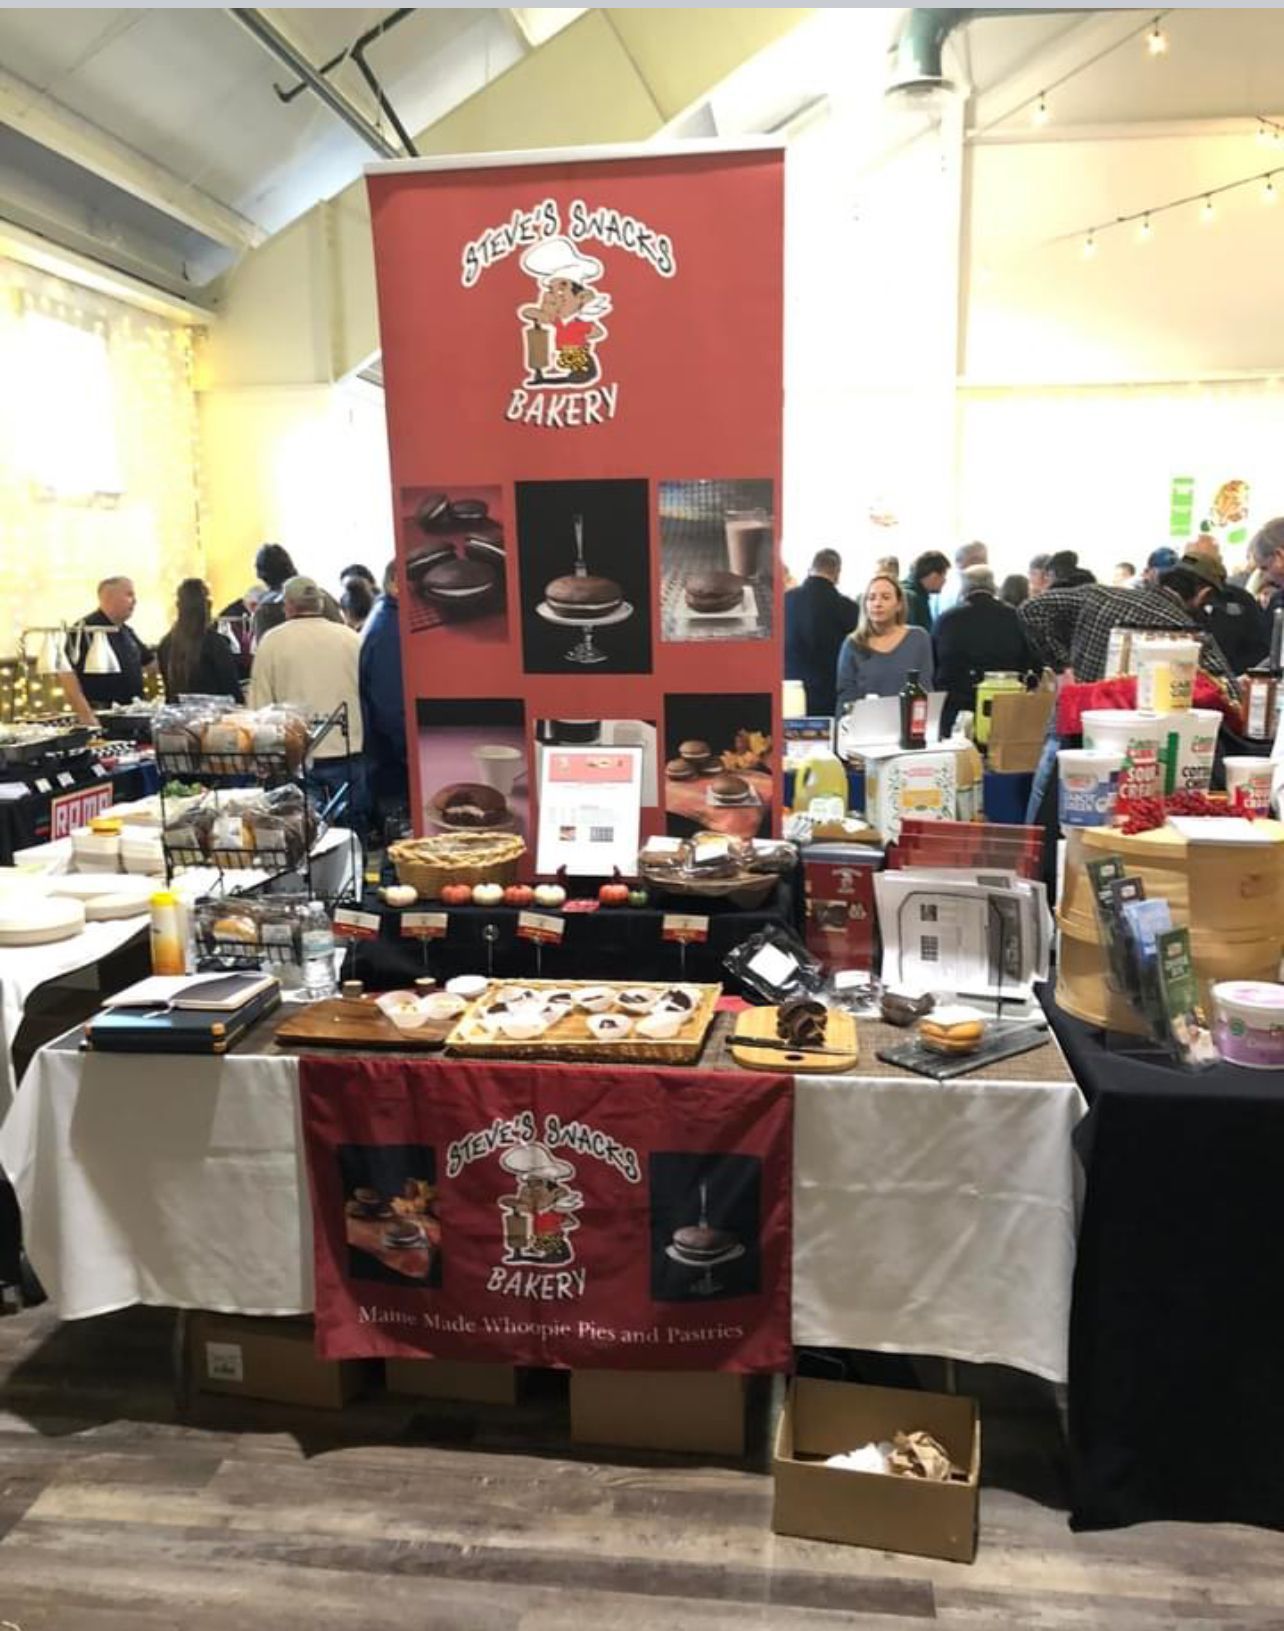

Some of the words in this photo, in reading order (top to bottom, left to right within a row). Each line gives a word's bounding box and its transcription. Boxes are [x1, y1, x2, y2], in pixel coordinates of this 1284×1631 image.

[461, 198, 560, 287] STEVE'S
[569, 200, 677, 277] SNACKS
[505, 382, 619, 428] BAKERY
[446, 1111, 535, 1178] STEVE'S
[545, 1114, 641, 1184] SNACKS
[487, 1267, 586, 1300] BAKERY
[359, 1305, 418, 1325] Maine
[423, 1312, 477, 1333] Made
[483, 1316, 572, 1342] Whoopie
[578, 1319, 616, 1342] Pies
[620, 1326, 659, 1344] and
[667, 1322, 744, 1344] Pastries
